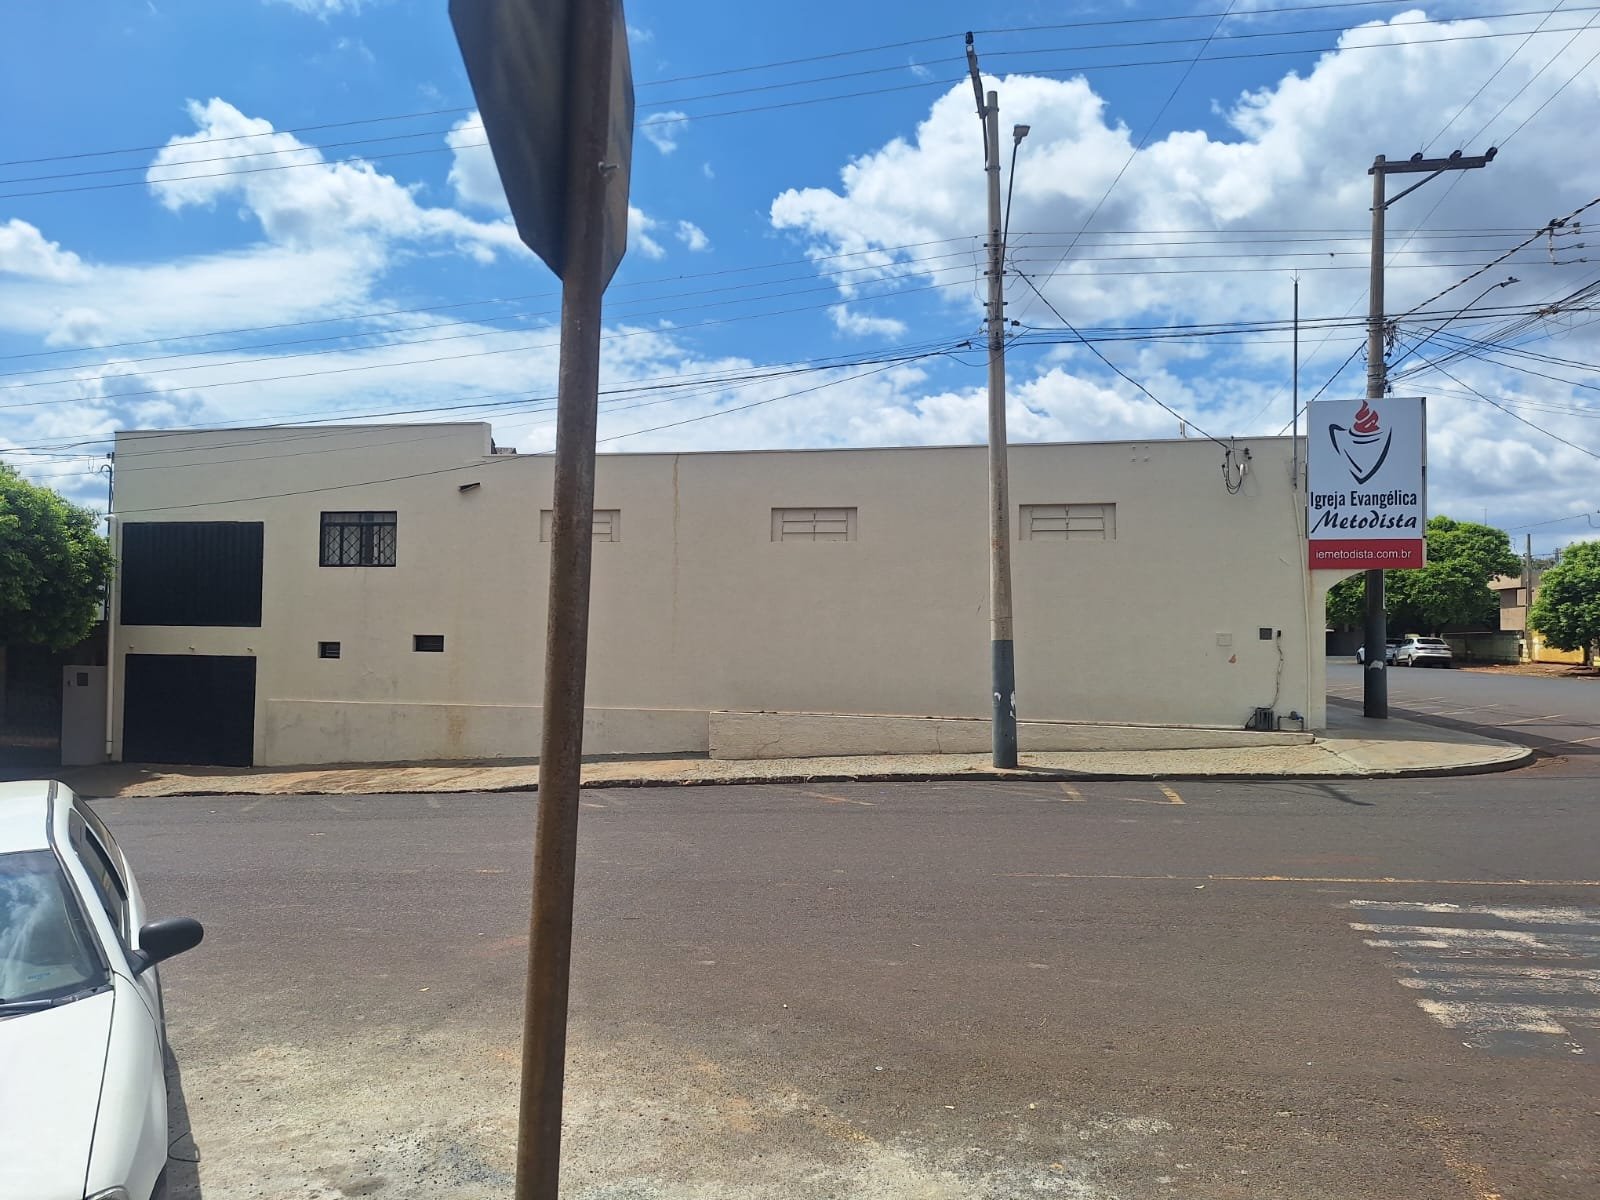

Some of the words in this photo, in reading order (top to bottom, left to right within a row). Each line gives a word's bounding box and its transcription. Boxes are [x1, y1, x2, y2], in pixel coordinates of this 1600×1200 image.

[1310, 491, 1345, 510] Igreja
[1350, 490, 1417, 509] Evangélica
[1310, 510, 1417, 534] Metodista
[1316, 549, 1412, 559] iemetodista.com.br
